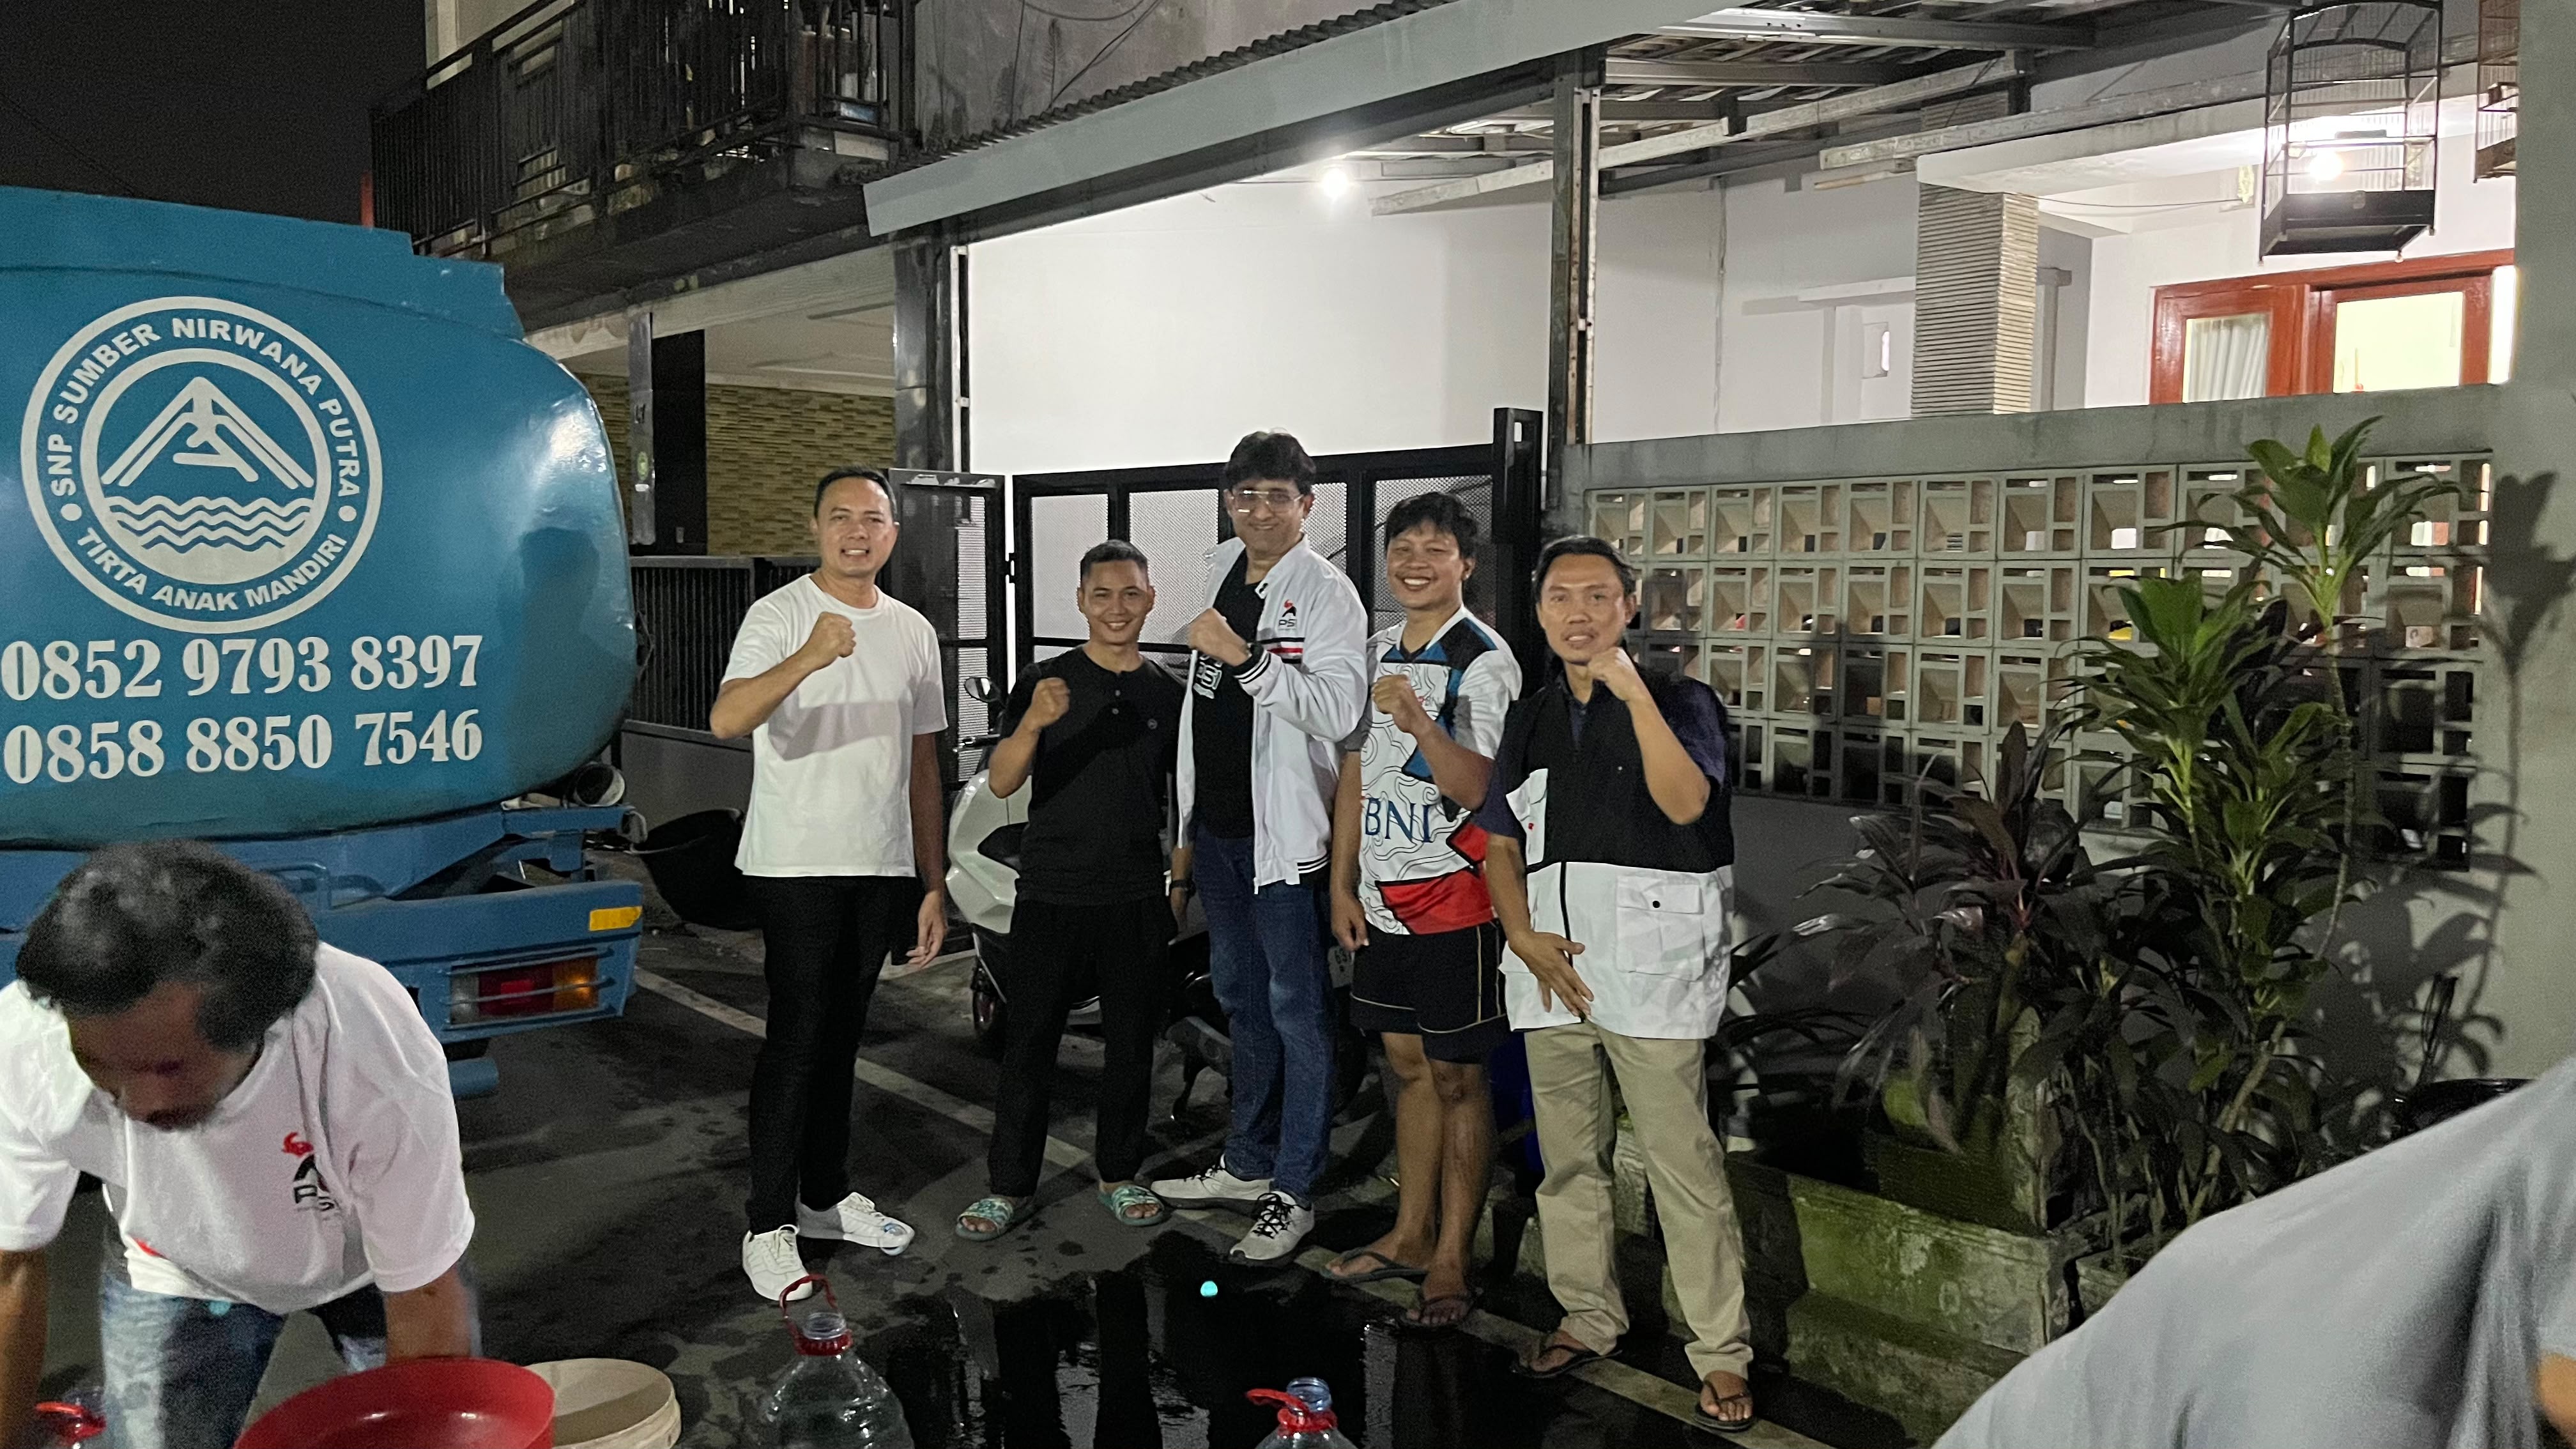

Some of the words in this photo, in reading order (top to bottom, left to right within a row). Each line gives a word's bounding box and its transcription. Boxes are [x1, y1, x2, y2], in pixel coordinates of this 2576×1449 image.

[53, 323, 161, 424] SUMBER
[172, 318, 322, 395] NIRWANA
[47, 434, 77, 496] SNP
[319, 398, 361, 497] PUTRA
[77, 527, 147, 595] TIRTA
[151, 585, 239, 611] ANAK
[245, 533, 348, 607] MANDIRI
[1, 640, 162, 701] 0852
[182, 637, 332, 696] 9793
[351, 634, 483, 690] 8397
[3, 720, 165, 784] 0858
[186, 714, 333, 773] 8850
[355, 709, 483, 765] 7546
[1365, 797, 1434, 843] BNI
